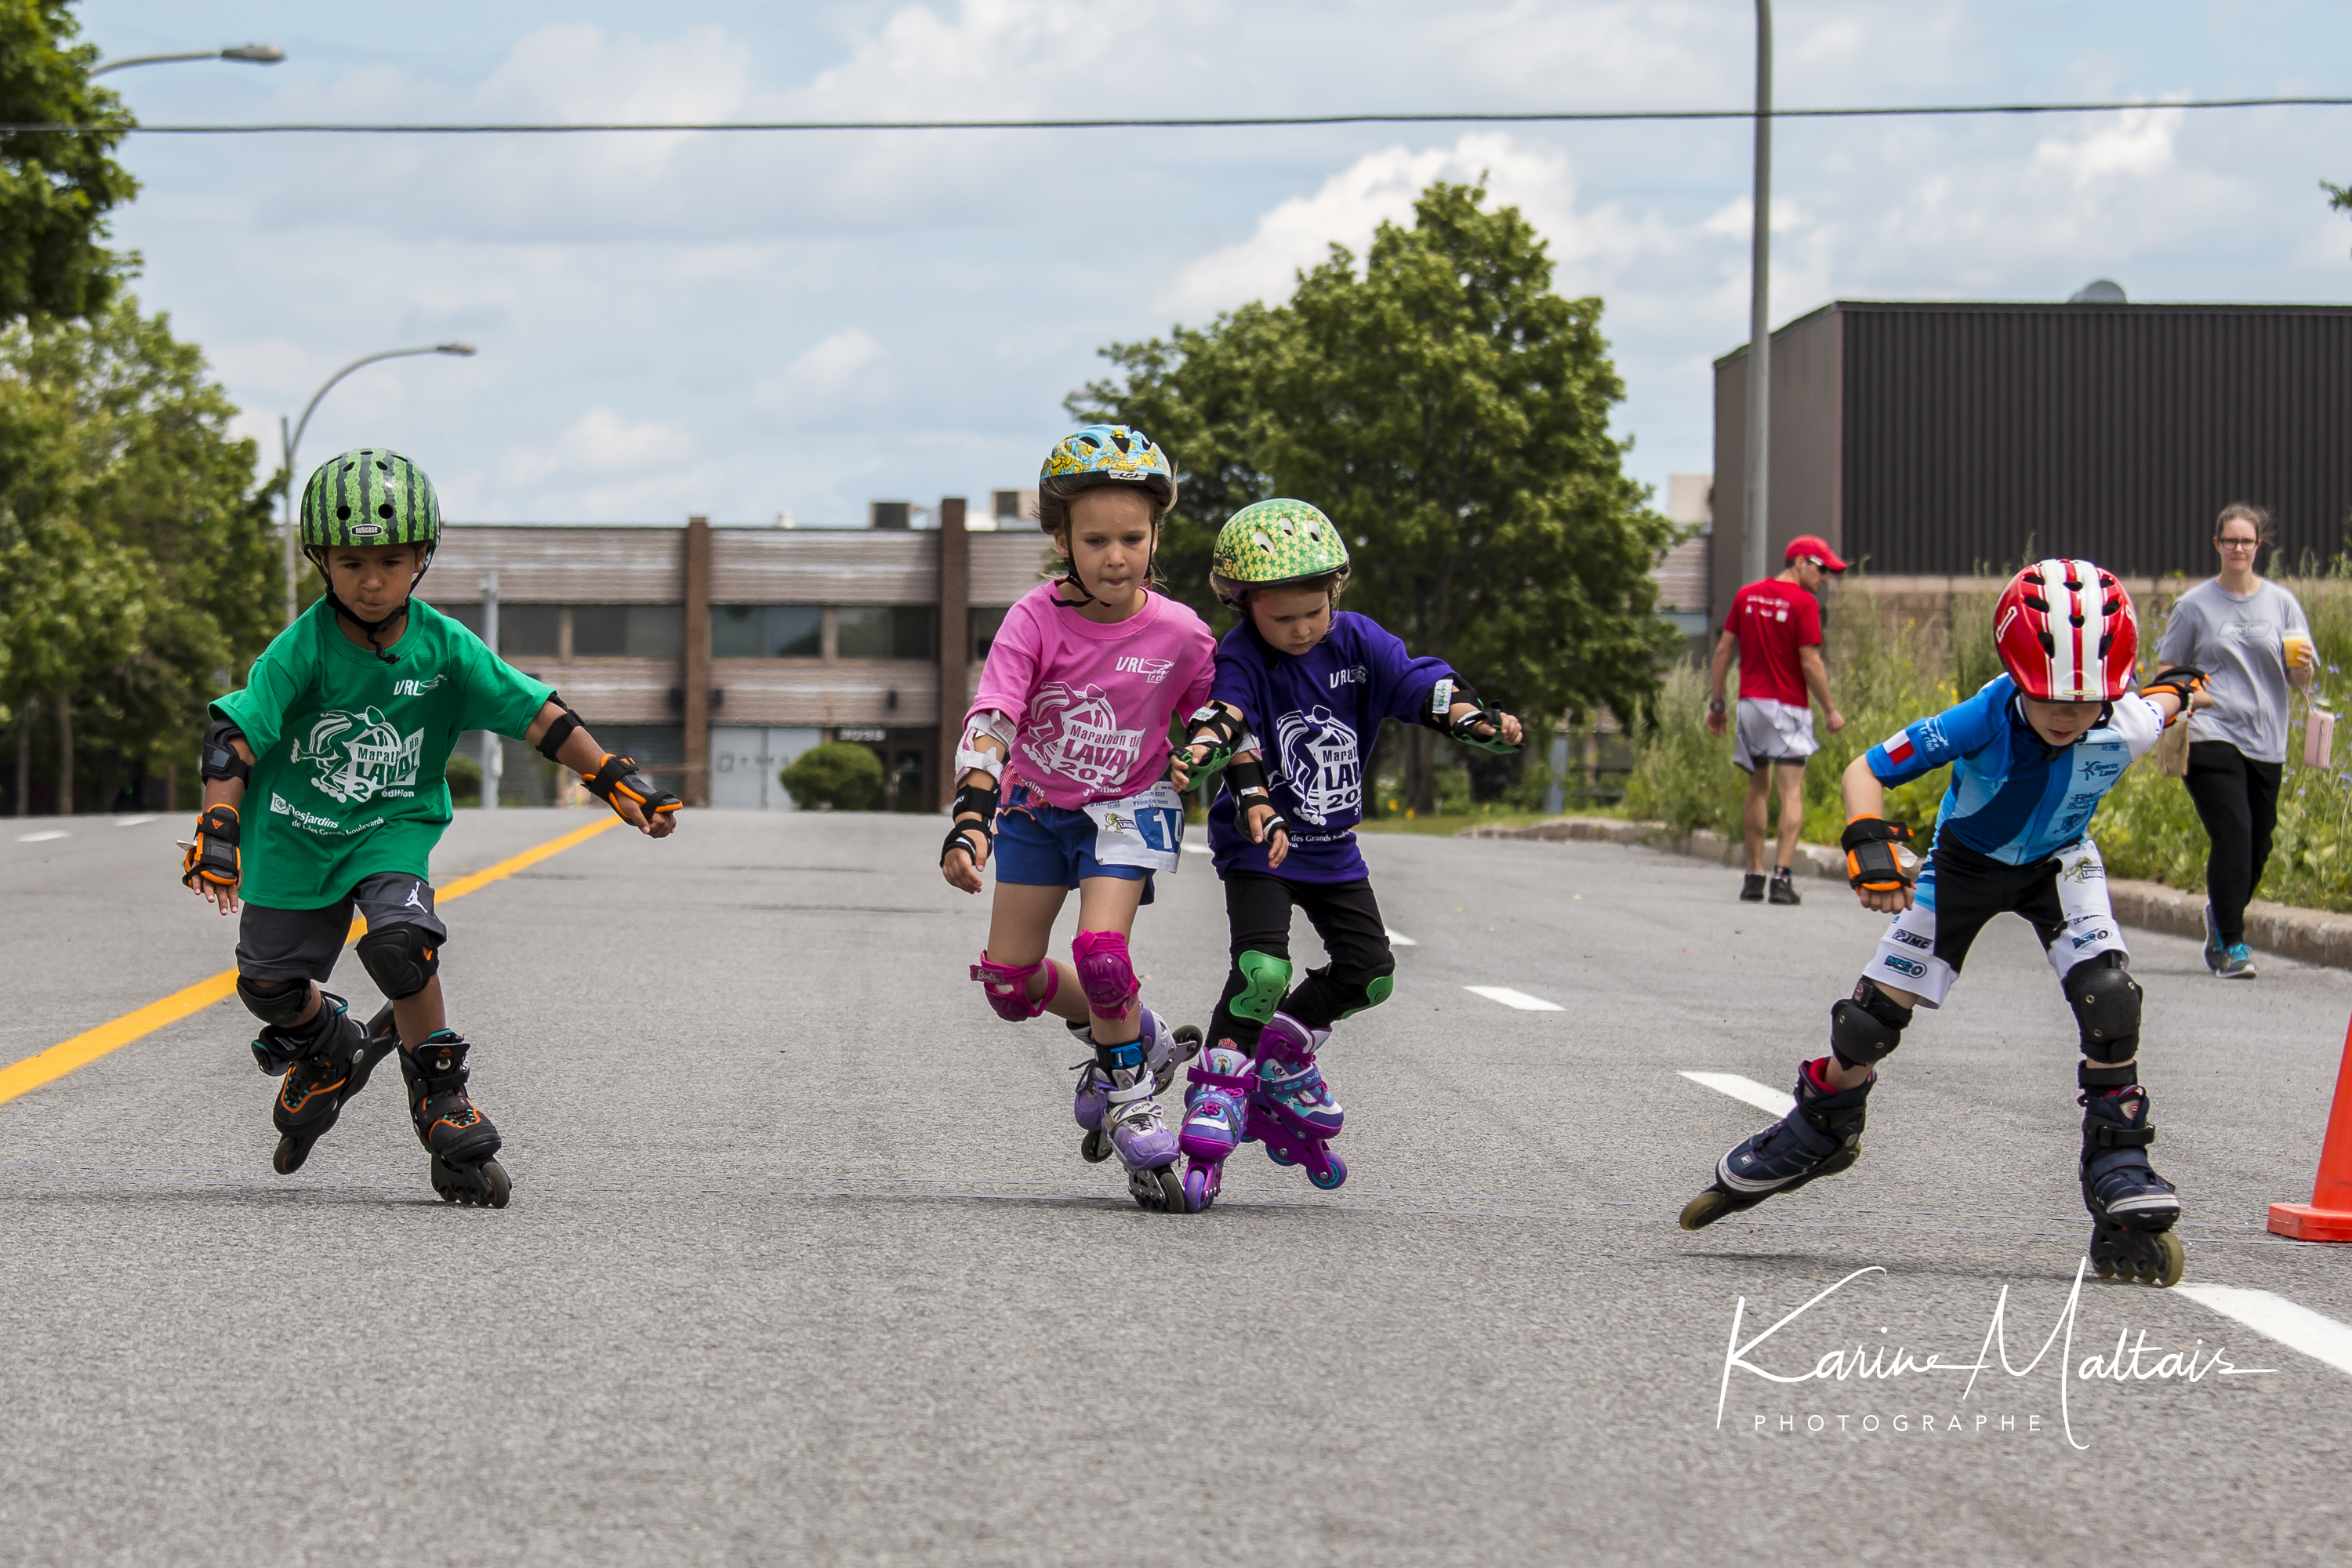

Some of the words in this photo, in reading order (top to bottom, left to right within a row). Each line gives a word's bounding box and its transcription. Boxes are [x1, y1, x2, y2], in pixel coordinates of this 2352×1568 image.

[1116, 656, 1153, 673] VRL
[1330, 669, 1355, 688] VRL
[393, 679, 424, 696] VRL
[409, 736, 419, 750] de
[1069, 724, 1127, 746] Marathon
[1323, 746, 1358, 764] Marat
[381, 788, 415, 797] édition
[1327, 788, 1361, 810] 20
[346, 816, 384, 836] boulevards
[977, 968, 1000, 982] Barbie
